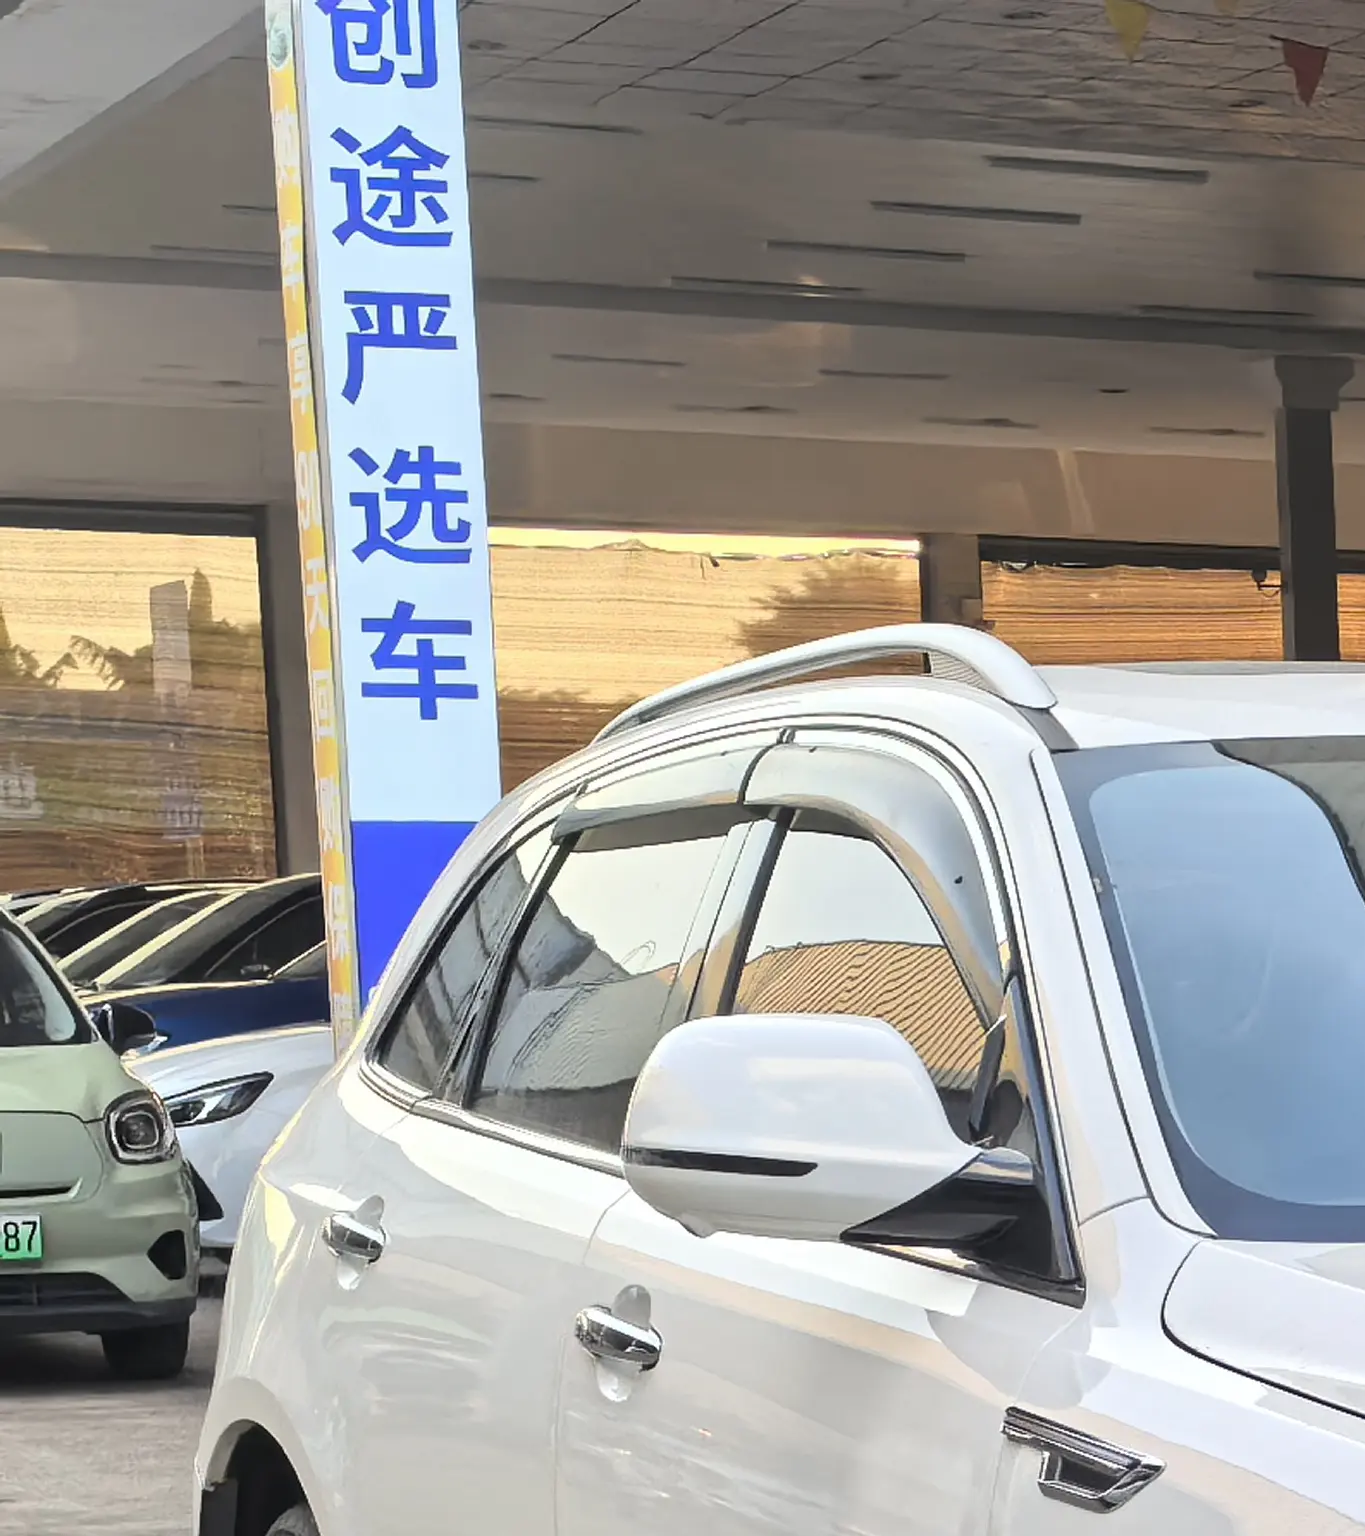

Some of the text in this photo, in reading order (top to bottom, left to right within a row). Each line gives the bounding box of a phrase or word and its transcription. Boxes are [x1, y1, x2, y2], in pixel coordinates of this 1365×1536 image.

[314, 0, 479, 722] 创途严选车
[2, 1220, 38, 1253] 87
